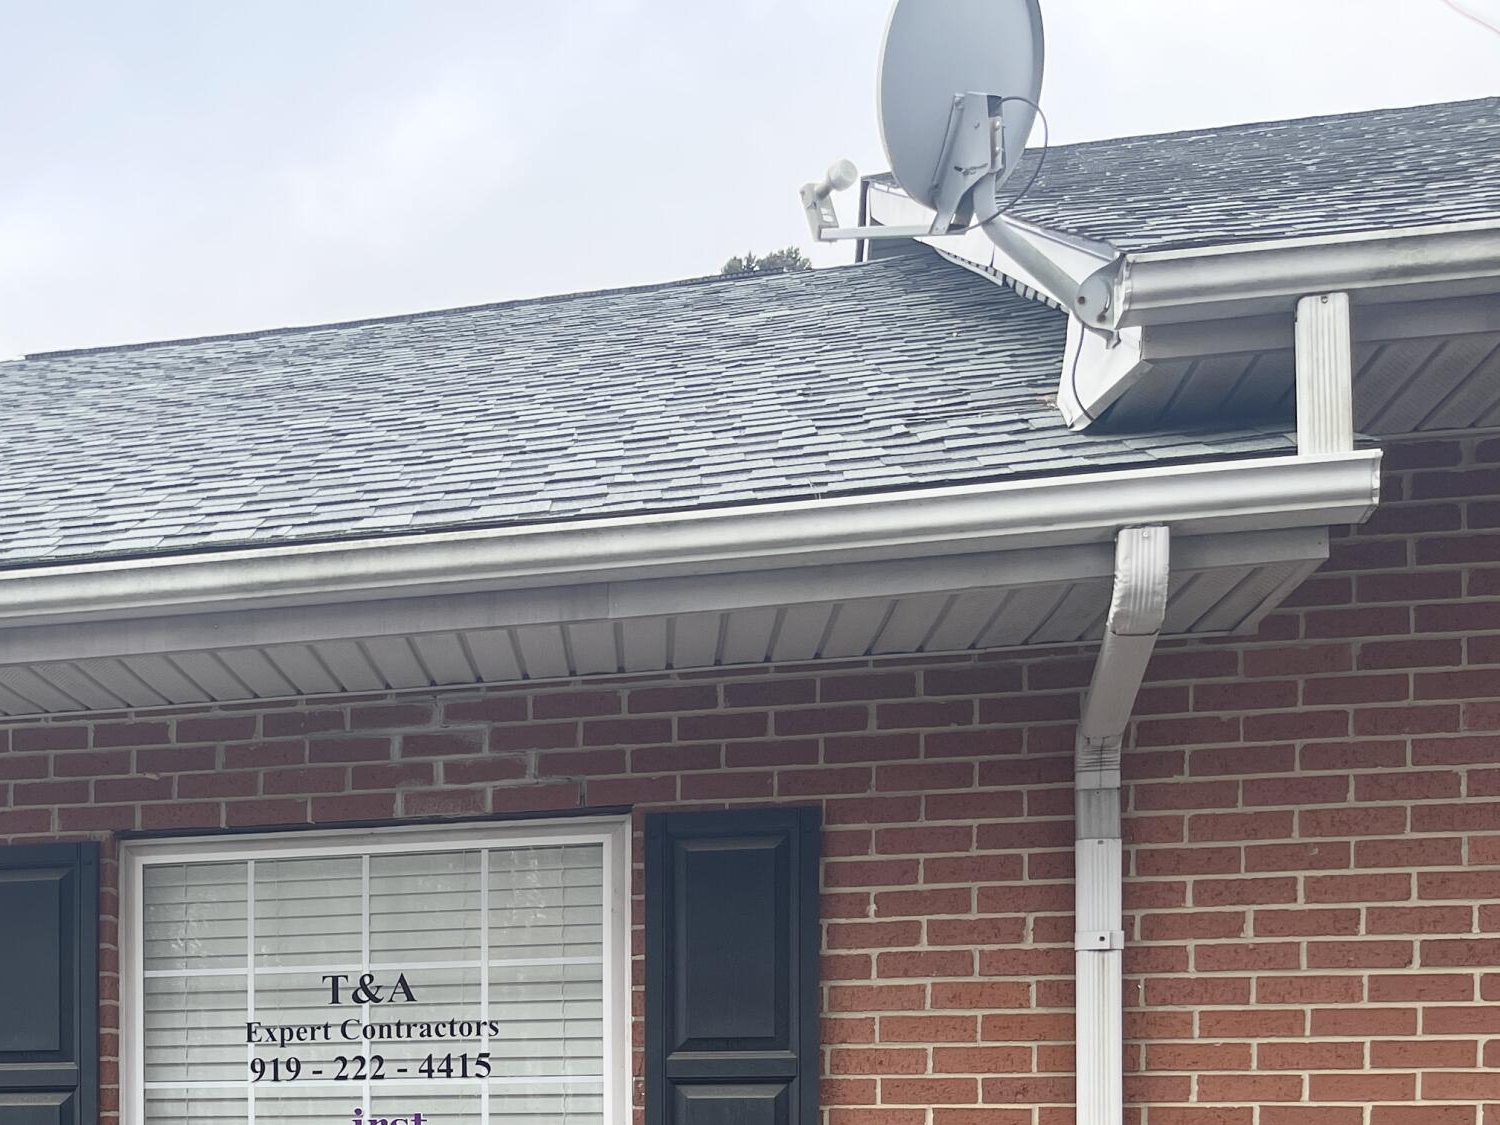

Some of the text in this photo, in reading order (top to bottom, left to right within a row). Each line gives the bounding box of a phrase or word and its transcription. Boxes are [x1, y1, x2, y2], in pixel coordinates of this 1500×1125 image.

[322, 972, 418, 1005] T&A
[245, 1017, 500, 1048] Expert Contractors
[418, 1052, 493, 1079] 4415
